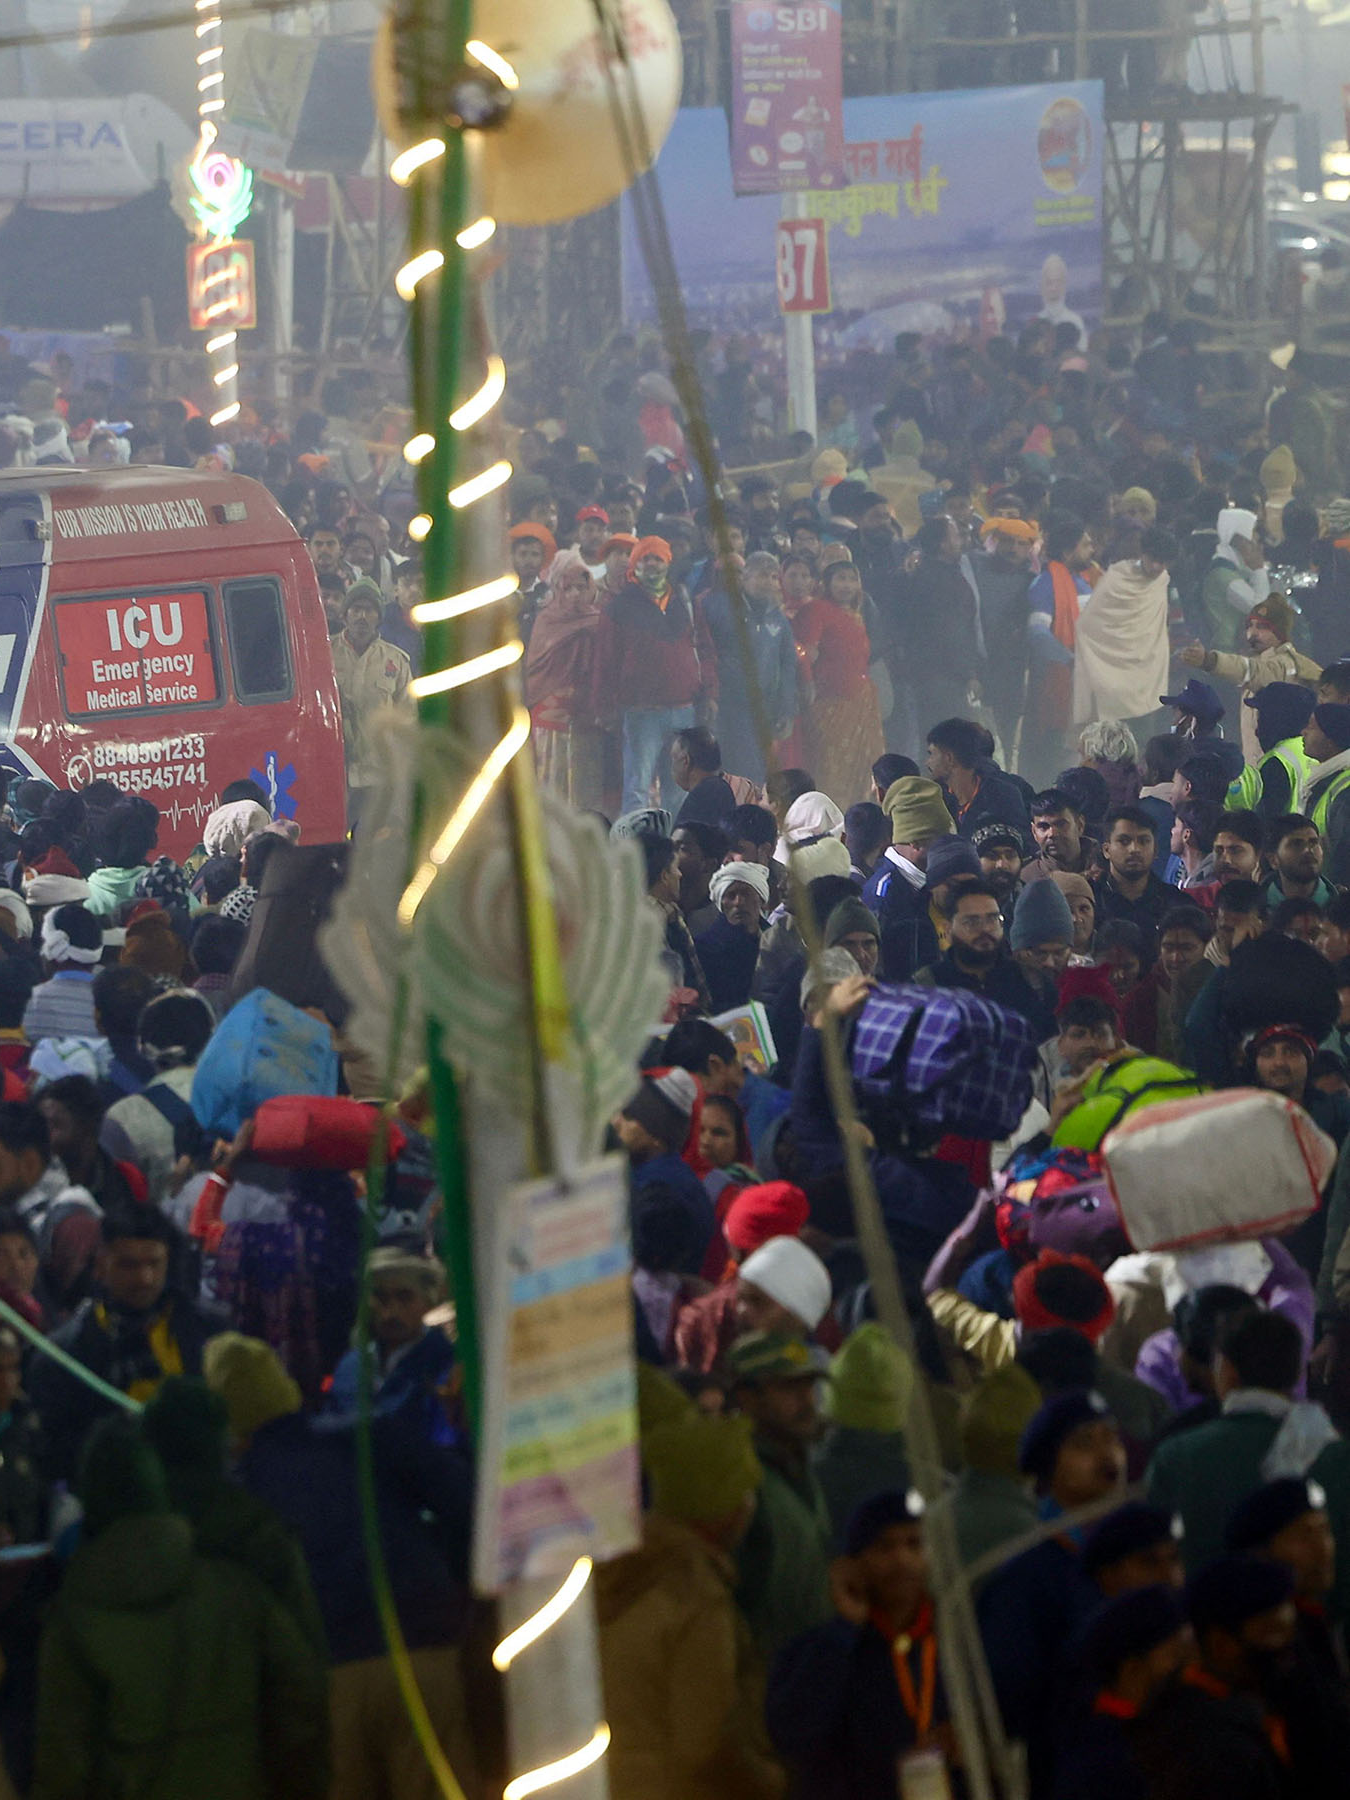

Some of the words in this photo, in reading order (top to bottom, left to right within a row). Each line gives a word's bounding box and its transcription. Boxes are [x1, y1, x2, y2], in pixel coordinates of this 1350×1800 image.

[777, 8, 827, 32] SBI
[54, 509, 82, 539] OUR
[76, 504, 126, 537] MISSION
[121, 503, 138, 533] IS
[133, 501, 167, 532] YOUR
[161, 498, 209, 529] HEALTH
[106, 602, 183, 651] ICU
[91, 653, 194, 684] Emergency
[86, 685, 142, 711] Medical
[145, 681, 198, 704] Service
